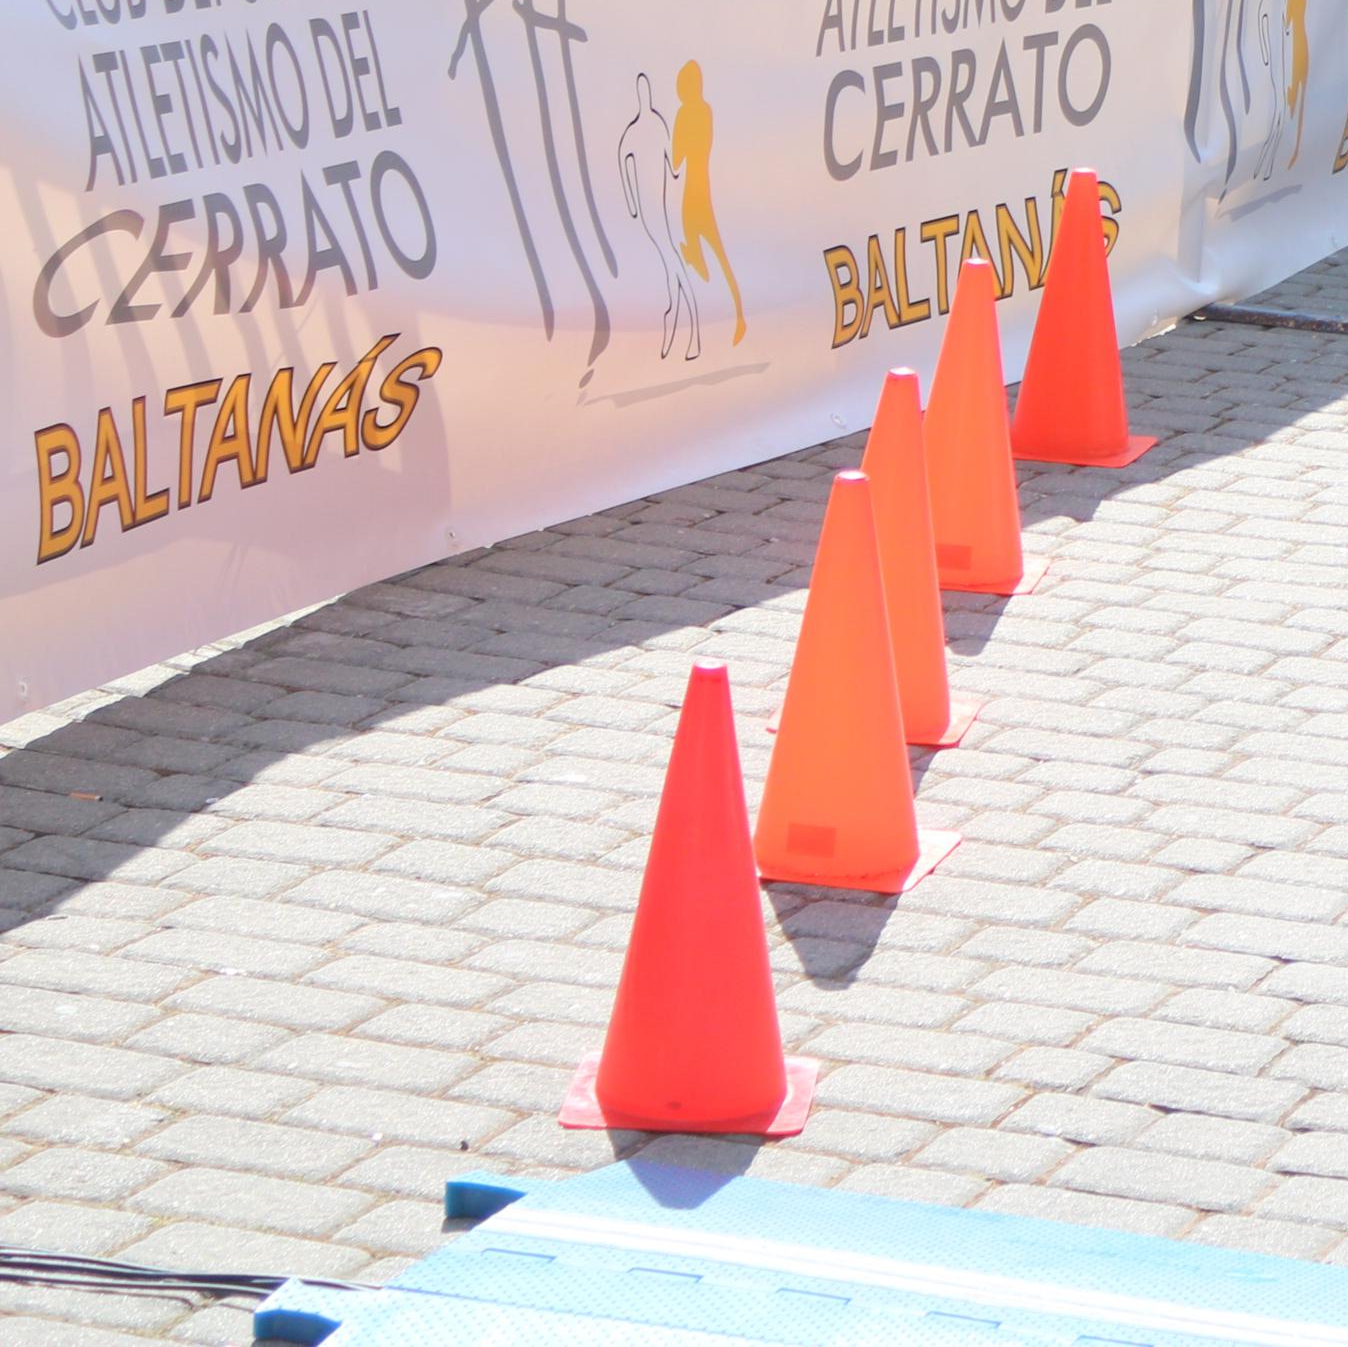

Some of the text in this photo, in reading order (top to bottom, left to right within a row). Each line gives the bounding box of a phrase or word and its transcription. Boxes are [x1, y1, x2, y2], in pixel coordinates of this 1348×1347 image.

[78, 9, 401, 192] ATLETISMO DEL
[823, 24, 1111, 182] CERRATO
[33, 150, 437, 338] CERRATO
[35, 333, 443, 565] BALTANÁS
